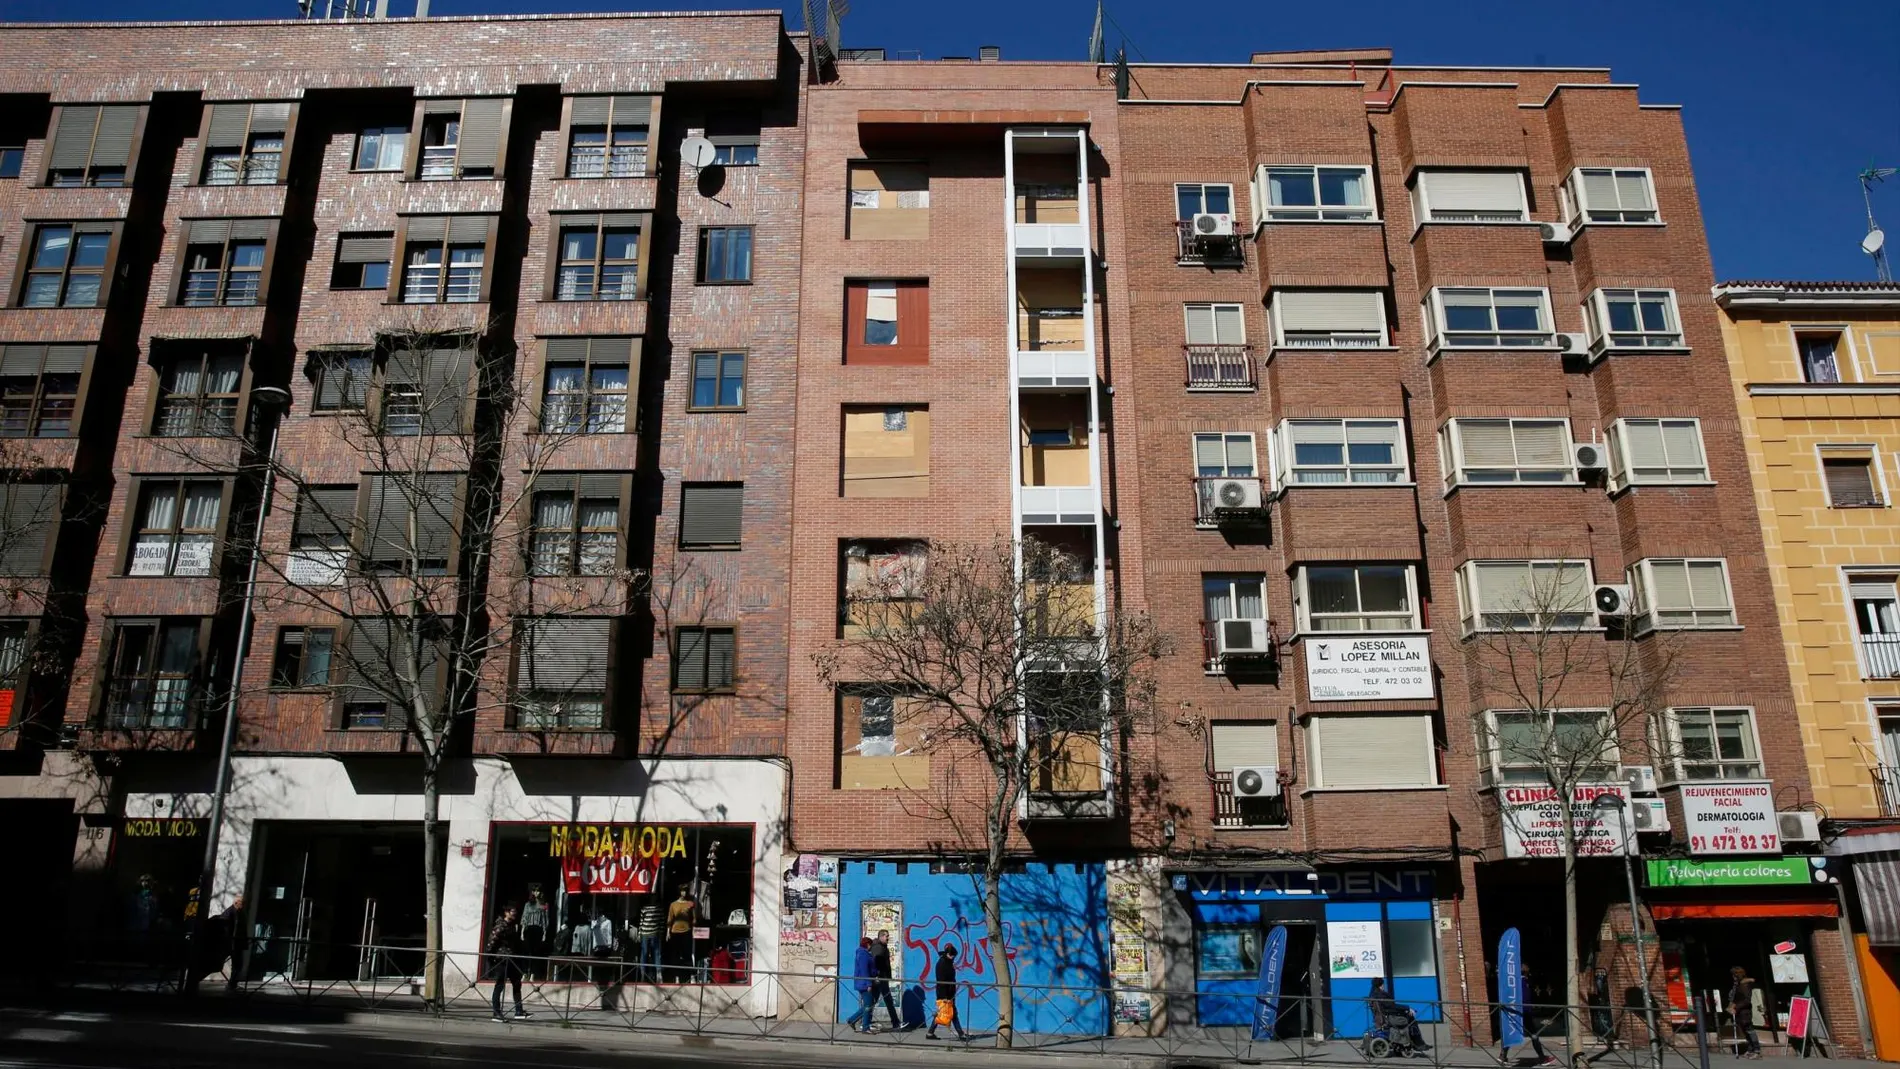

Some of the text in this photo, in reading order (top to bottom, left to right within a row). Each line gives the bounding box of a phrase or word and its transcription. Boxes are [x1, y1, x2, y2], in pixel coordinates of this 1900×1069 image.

[1352, 640, 1406, 650] ASESORIA
[1341, 652, 1420, 662] LOPEZ MILLAN
[1506, 788, 1561, 802] CLINIC
[1685, 788, 1767, 796] REJUVENECIMIENTO
[1714, 798, 1742, 806] FACIAL
[1697, 812, 1765, 822] DERMATOLOGIA
[125, 822, 160, 836] MODA
[550, 825, 686, 858] MODA MODA
[1691, 834, 1777, 850] 91 472 82 37
[1743, 864, 1792, 877] colores
[1190, 870, 1430, 895] VITALDENT
[1362, 950, 1377, 961] 25
